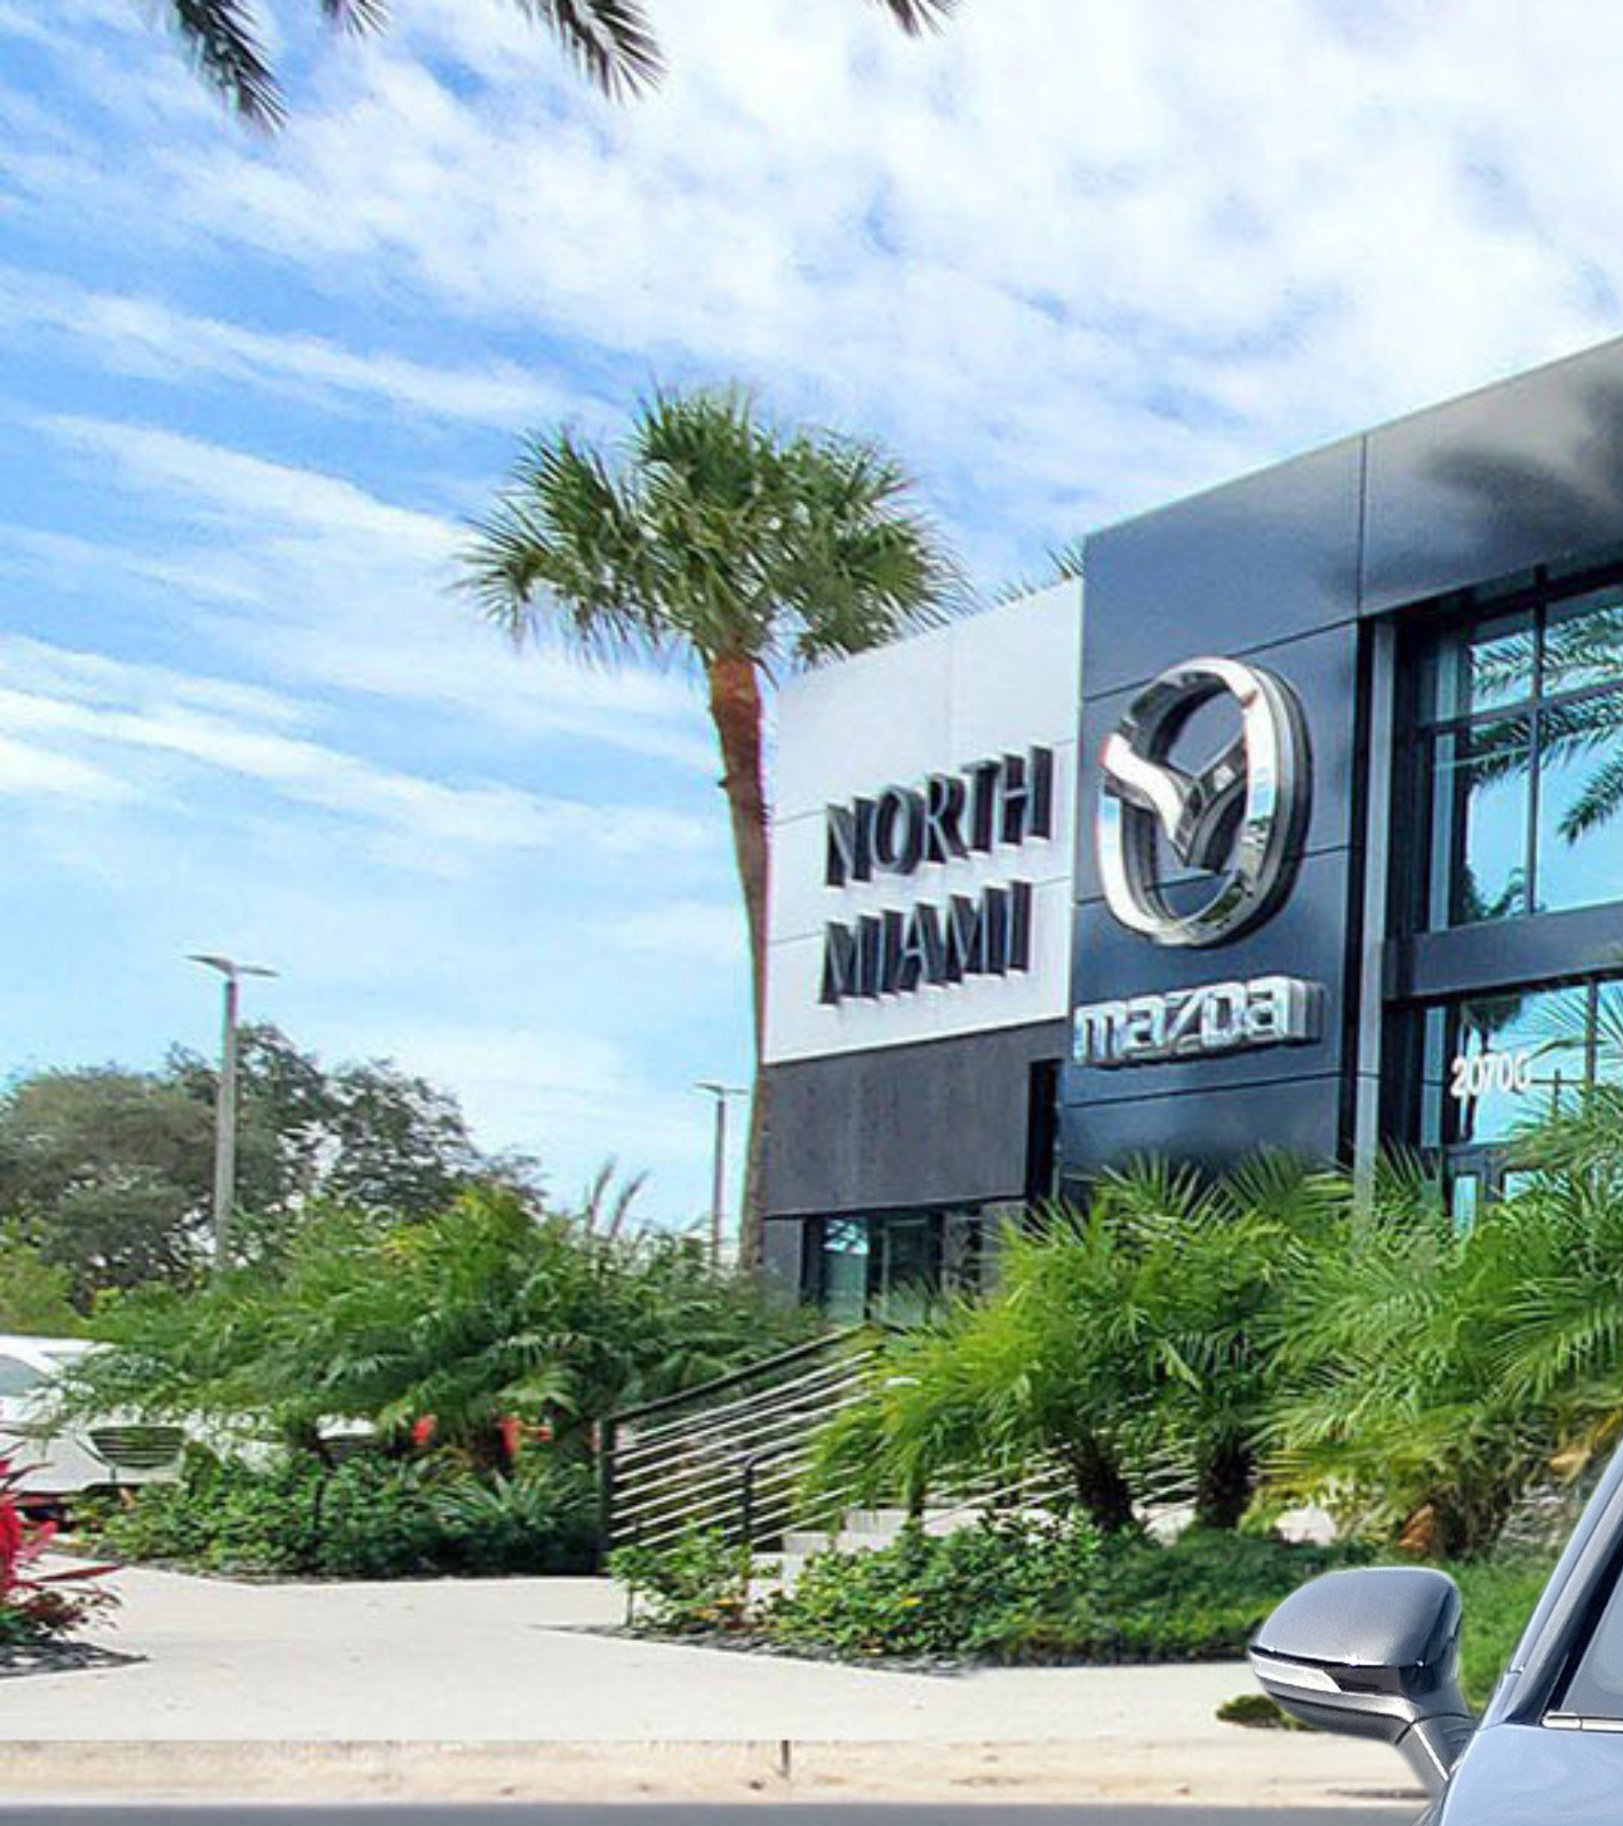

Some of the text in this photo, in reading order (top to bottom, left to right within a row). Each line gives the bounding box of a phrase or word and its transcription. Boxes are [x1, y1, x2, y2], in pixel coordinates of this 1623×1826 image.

[825, 745, 1053, 888] NORTH
[818, 879, 1032, 1005] MIAMI
[1072, 974, 1318, 1068] mazda
